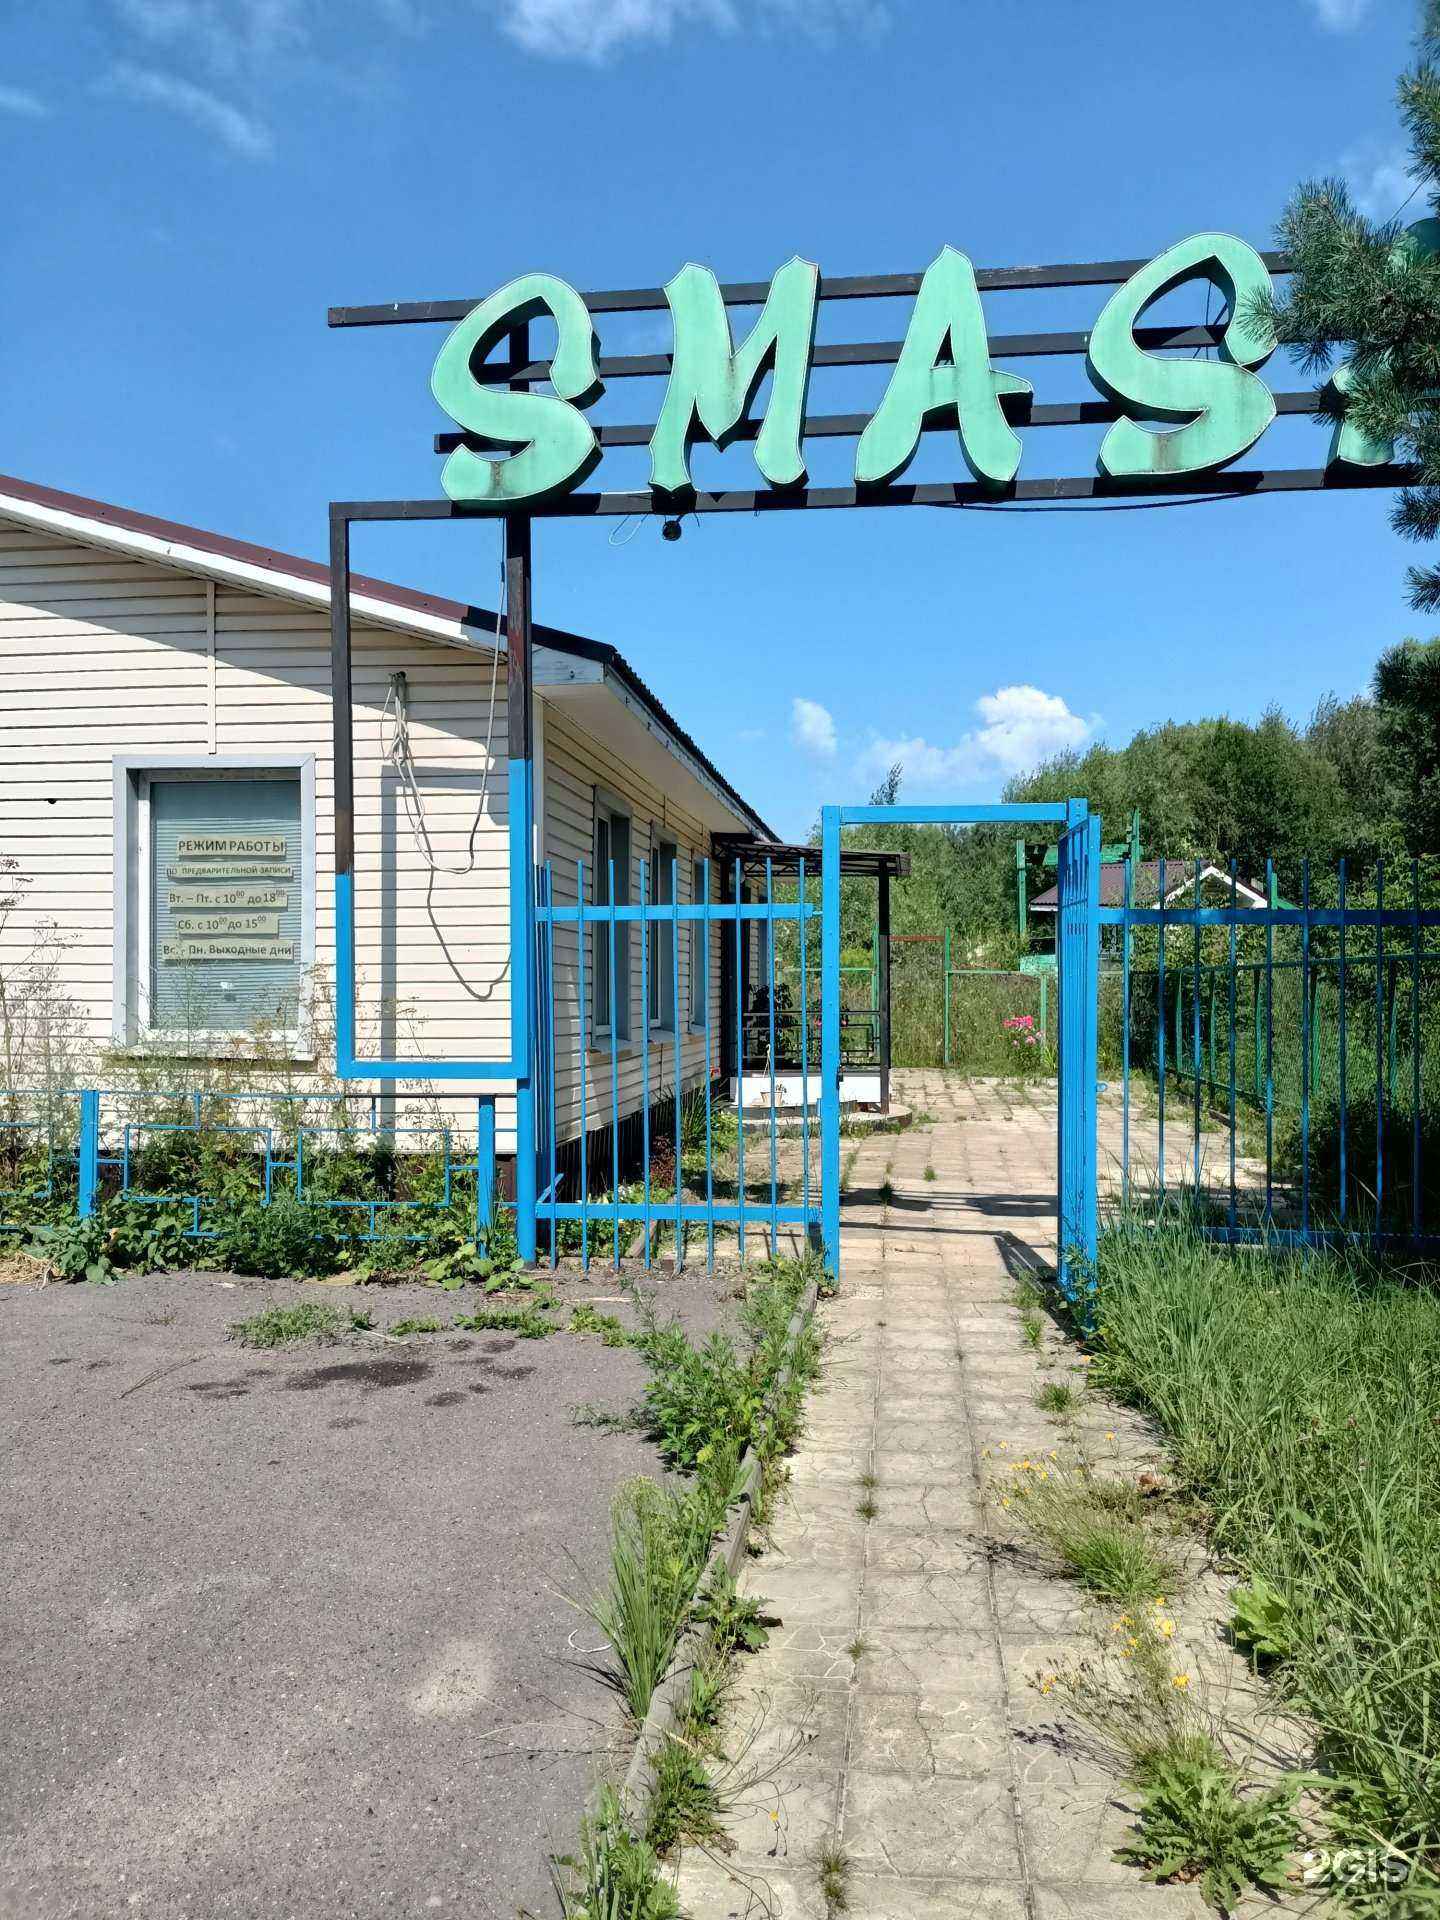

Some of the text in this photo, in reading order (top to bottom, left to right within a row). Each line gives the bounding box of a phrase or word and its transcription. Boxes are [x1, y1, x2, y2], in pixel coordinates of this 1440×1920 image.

[430, 232, 1396, 503] SMAS
[178, 840, 284, 852] РЕЖИМ РАБОТЫ
[182, 866, 258, 875] ПРЕДВАРИТЕЛЬНОЙ
[260, 866, 291, 874] ЗАПИСИ
[169, 893, 184, 903] Вт.
[196, 894, 212, 903] Пт.
[247, 895, 262, 905] до
[178, 920, 194, 930] Сб.
[227, 922, 242, 931] до
[189, 945, 207, 955] Пн.
[209, 944, 267, 955] Выходные
[269, 946, 292, 956] дни
